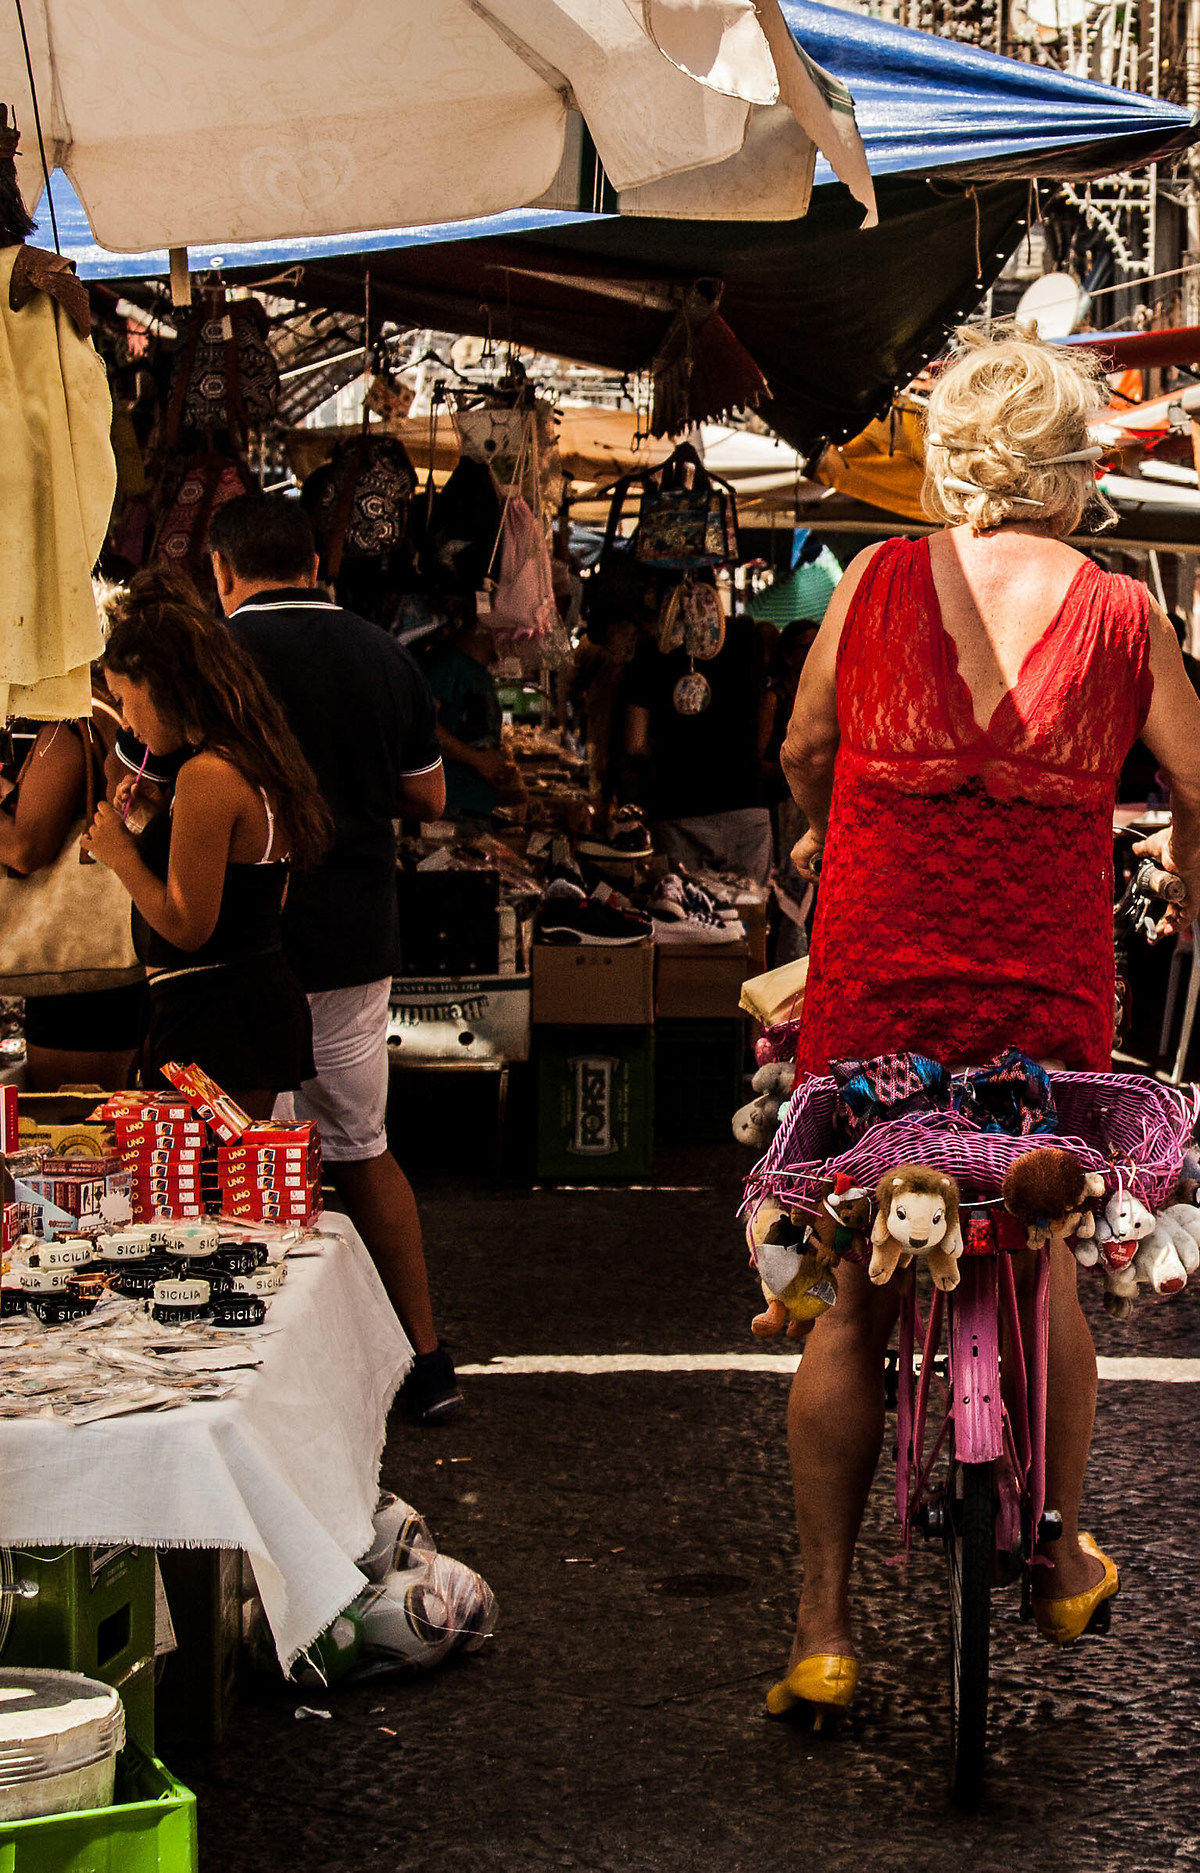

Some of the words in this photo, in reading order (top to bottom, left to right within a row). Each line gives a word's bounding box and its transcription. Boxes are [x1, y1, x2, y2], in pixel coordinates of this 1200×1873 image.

[179, 1083, 197, 1098] UNO
[581, 1062, 607, 1147] FORST
[111, 1107, 130, 1119] UNO
[125, 1121, 144, 1133] UNO
[126, 1136, 145, 1148] UNO
[121, 1150, 140, 1162] UNO
[227, 1149, 247, 1161] UNO
[227, 1162, 246, 1174] UNO
[227, 1176, 246, 1188] UNO
[232, 1190, 251, 1202] UNO
[232, 1203, 251, 1216] UNO
[49, 1250, 90, 1263] SICILIA
[160, 1290, 201, 1300] SICILIA
